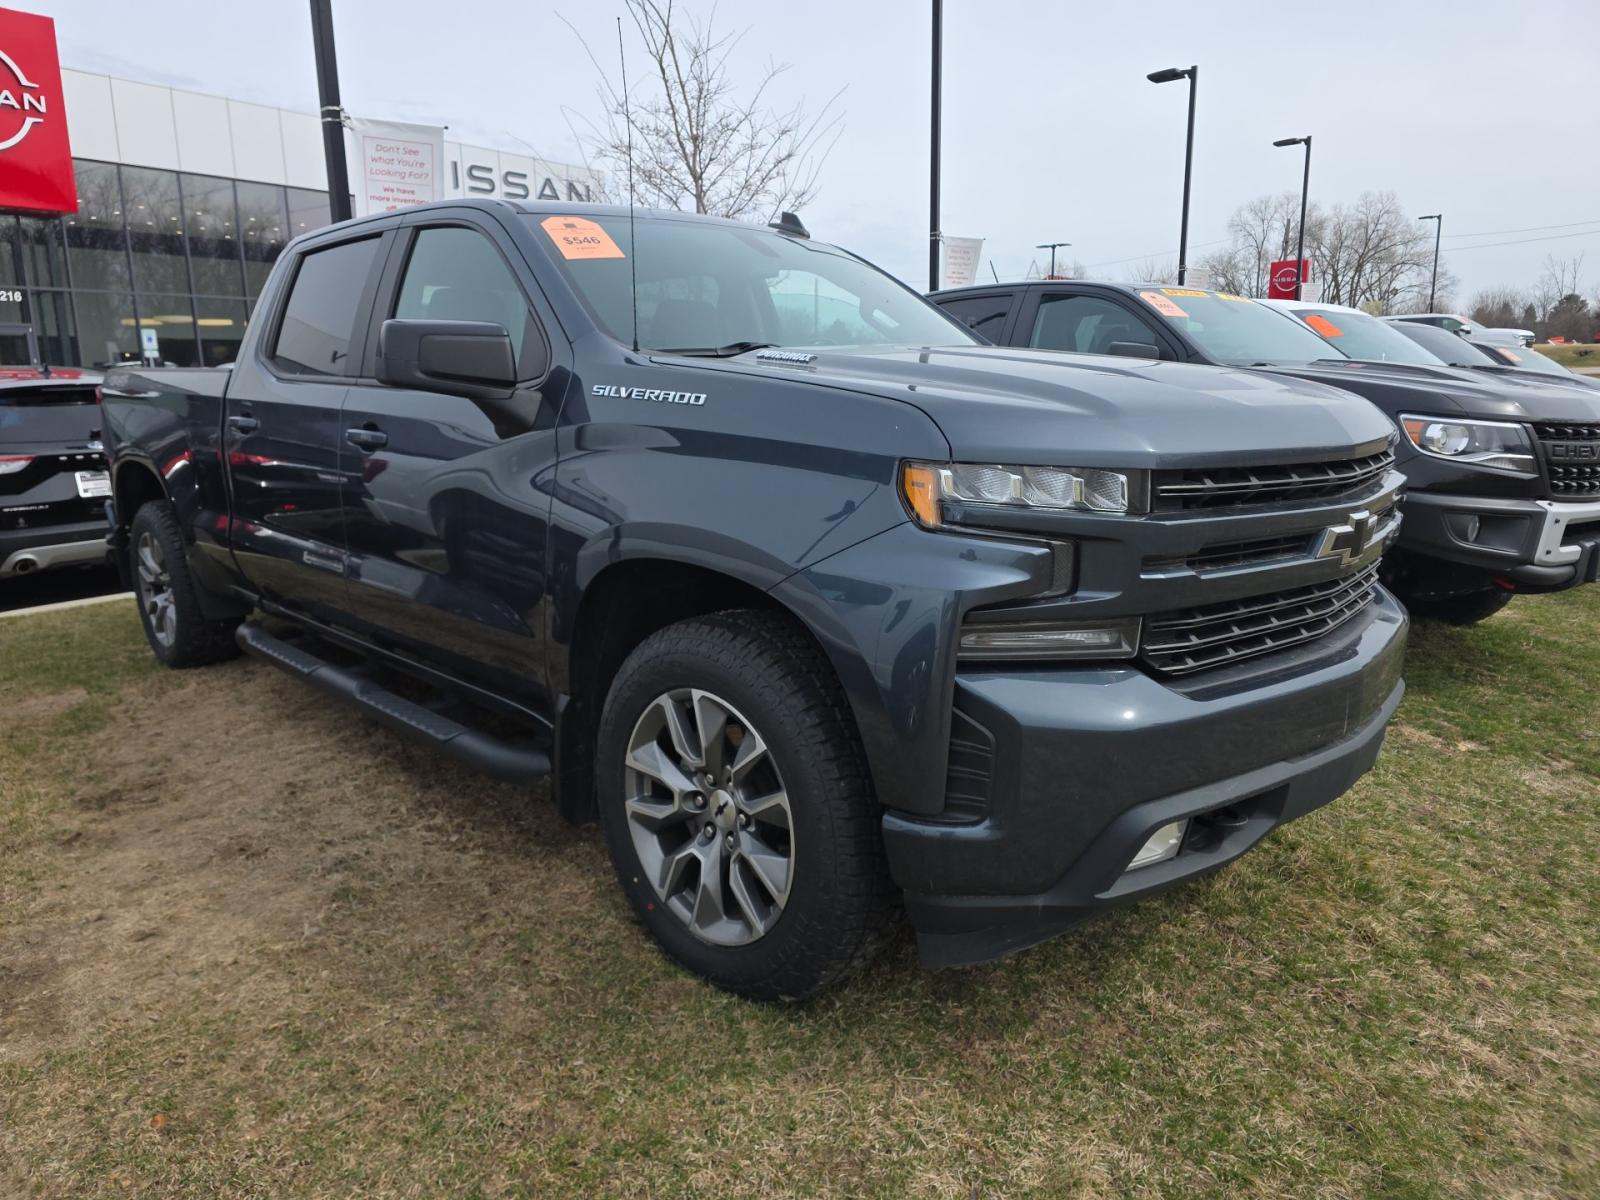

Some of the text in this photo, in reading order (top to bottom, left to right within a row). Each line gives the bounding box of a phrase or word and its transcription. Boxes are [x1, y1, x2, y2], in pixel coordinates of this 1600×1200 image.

[0, 90, 46, 113] AN
[401, 147, 420, 156] See
[369, 167, 407, 180] Looking
[451, 160, 590, 200] ISSAN
[591, 384, 708, 406] SILVERADO
[1551, 443, 1600, 460] CHEV
